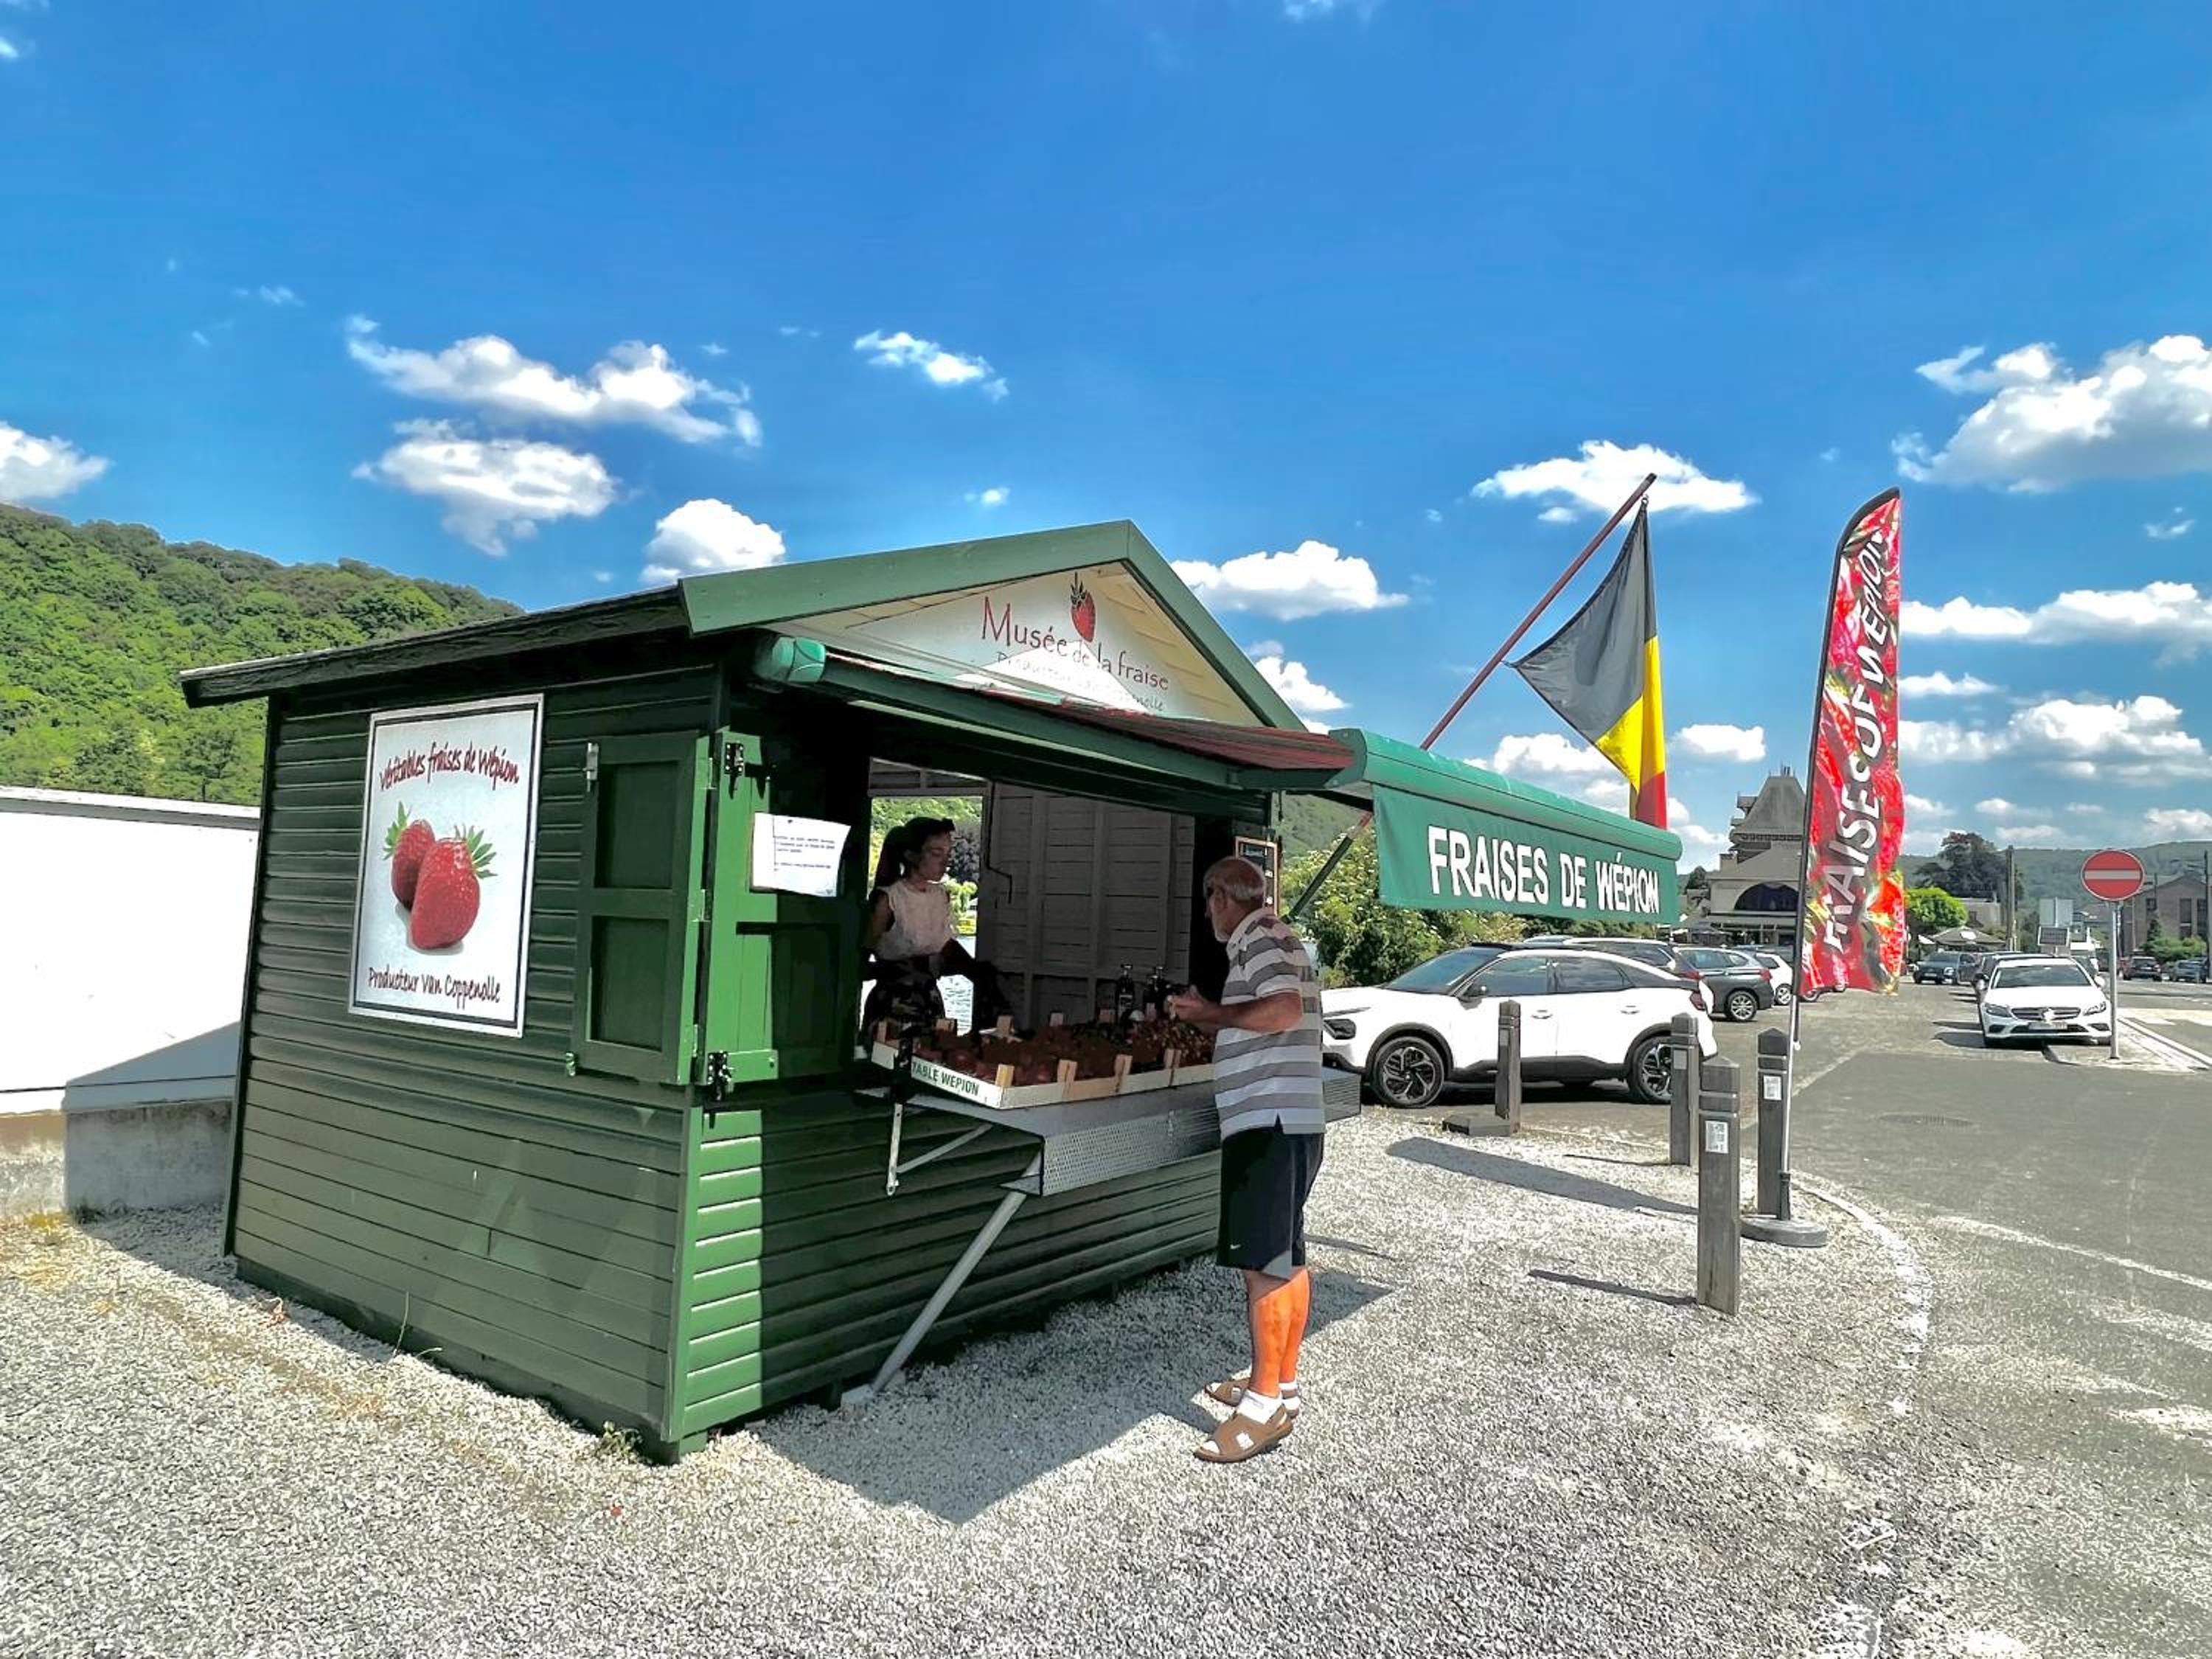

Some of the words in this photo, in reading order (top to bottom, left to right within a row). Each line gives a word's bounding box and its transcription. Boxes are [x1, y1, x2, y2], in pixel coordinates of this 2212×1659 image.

[981, 596, 1068, 657] Musée
[1072, 640, 1090, 664] de
[1097, 643, 1112, 674] la
[1117, 650, 1169, 690] fraise
[464, 740, 476, 773] de
[1427, 824, 1550, 905] FRAISES
[1559, 852, 1587, 909] DE
[1595, 851, 1660, 914] WÉPION
[368, 963, 420, 992] Producteur
[445, 974, 501, 1009] Coppenolle
